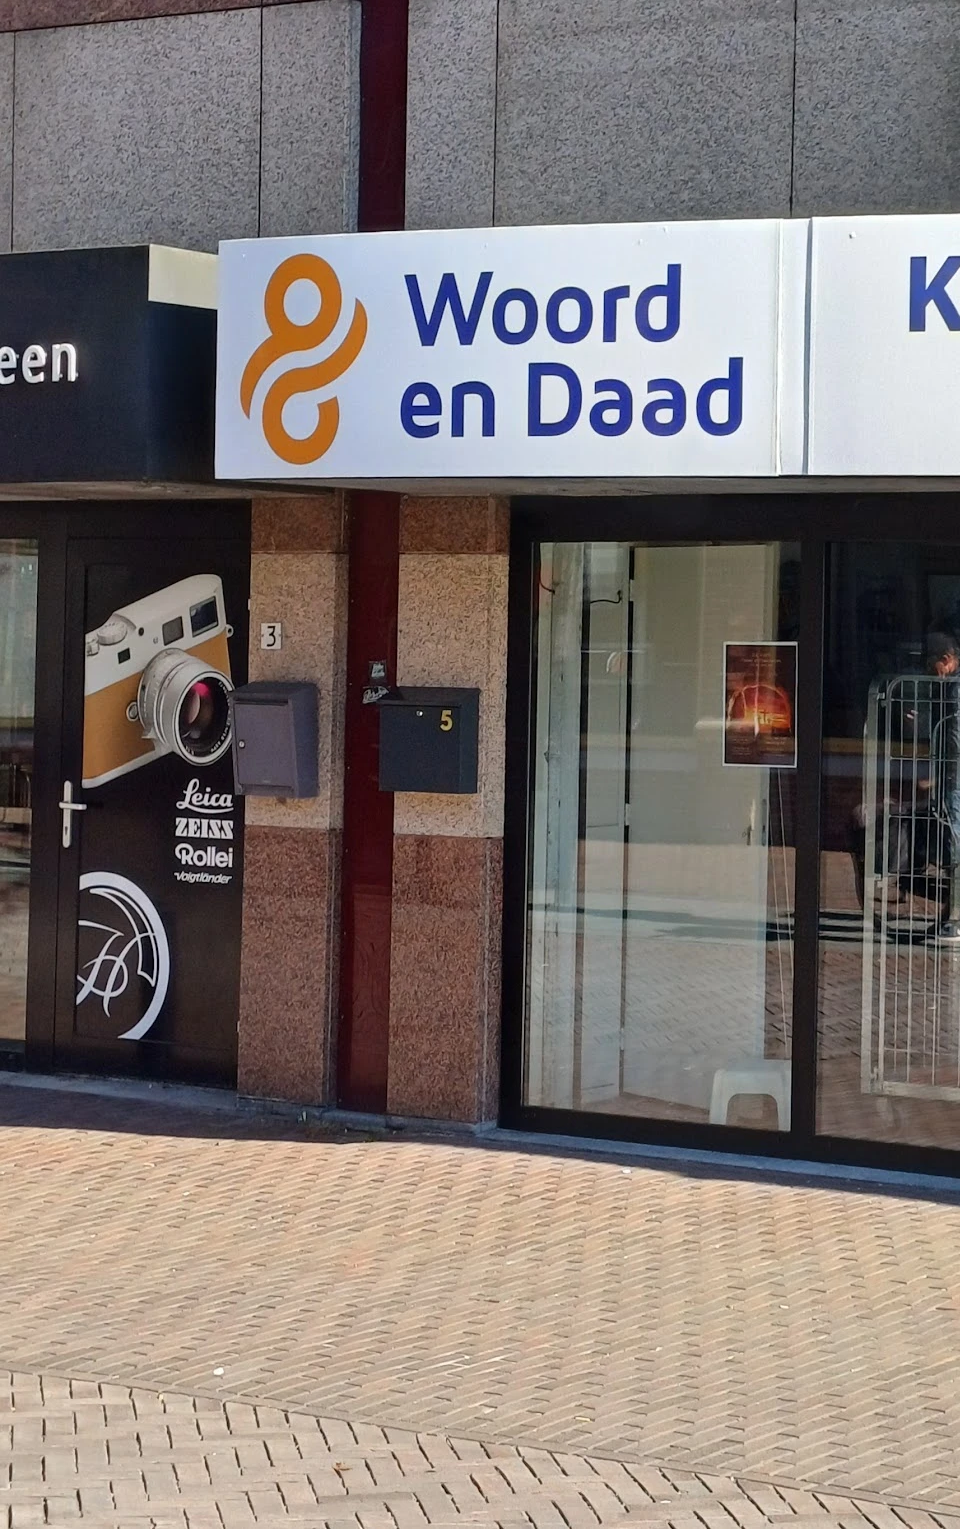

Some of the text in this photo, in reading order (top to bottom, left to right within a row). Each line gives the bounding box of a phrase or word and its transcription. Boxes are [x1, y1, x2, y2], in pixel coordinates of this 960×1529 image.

[405, 263, 681, 346] Woord
[0, 343, 77, 385] een
[400, 357, 742, 438] en Daad
[266, 625, 277, 647] 3
[439, 709, 453, 731] 5
[176, 778, 234, 814] Leica
[175, 817, 234, 840] ZEISS
[175, 842, 234, 868] Rollei
